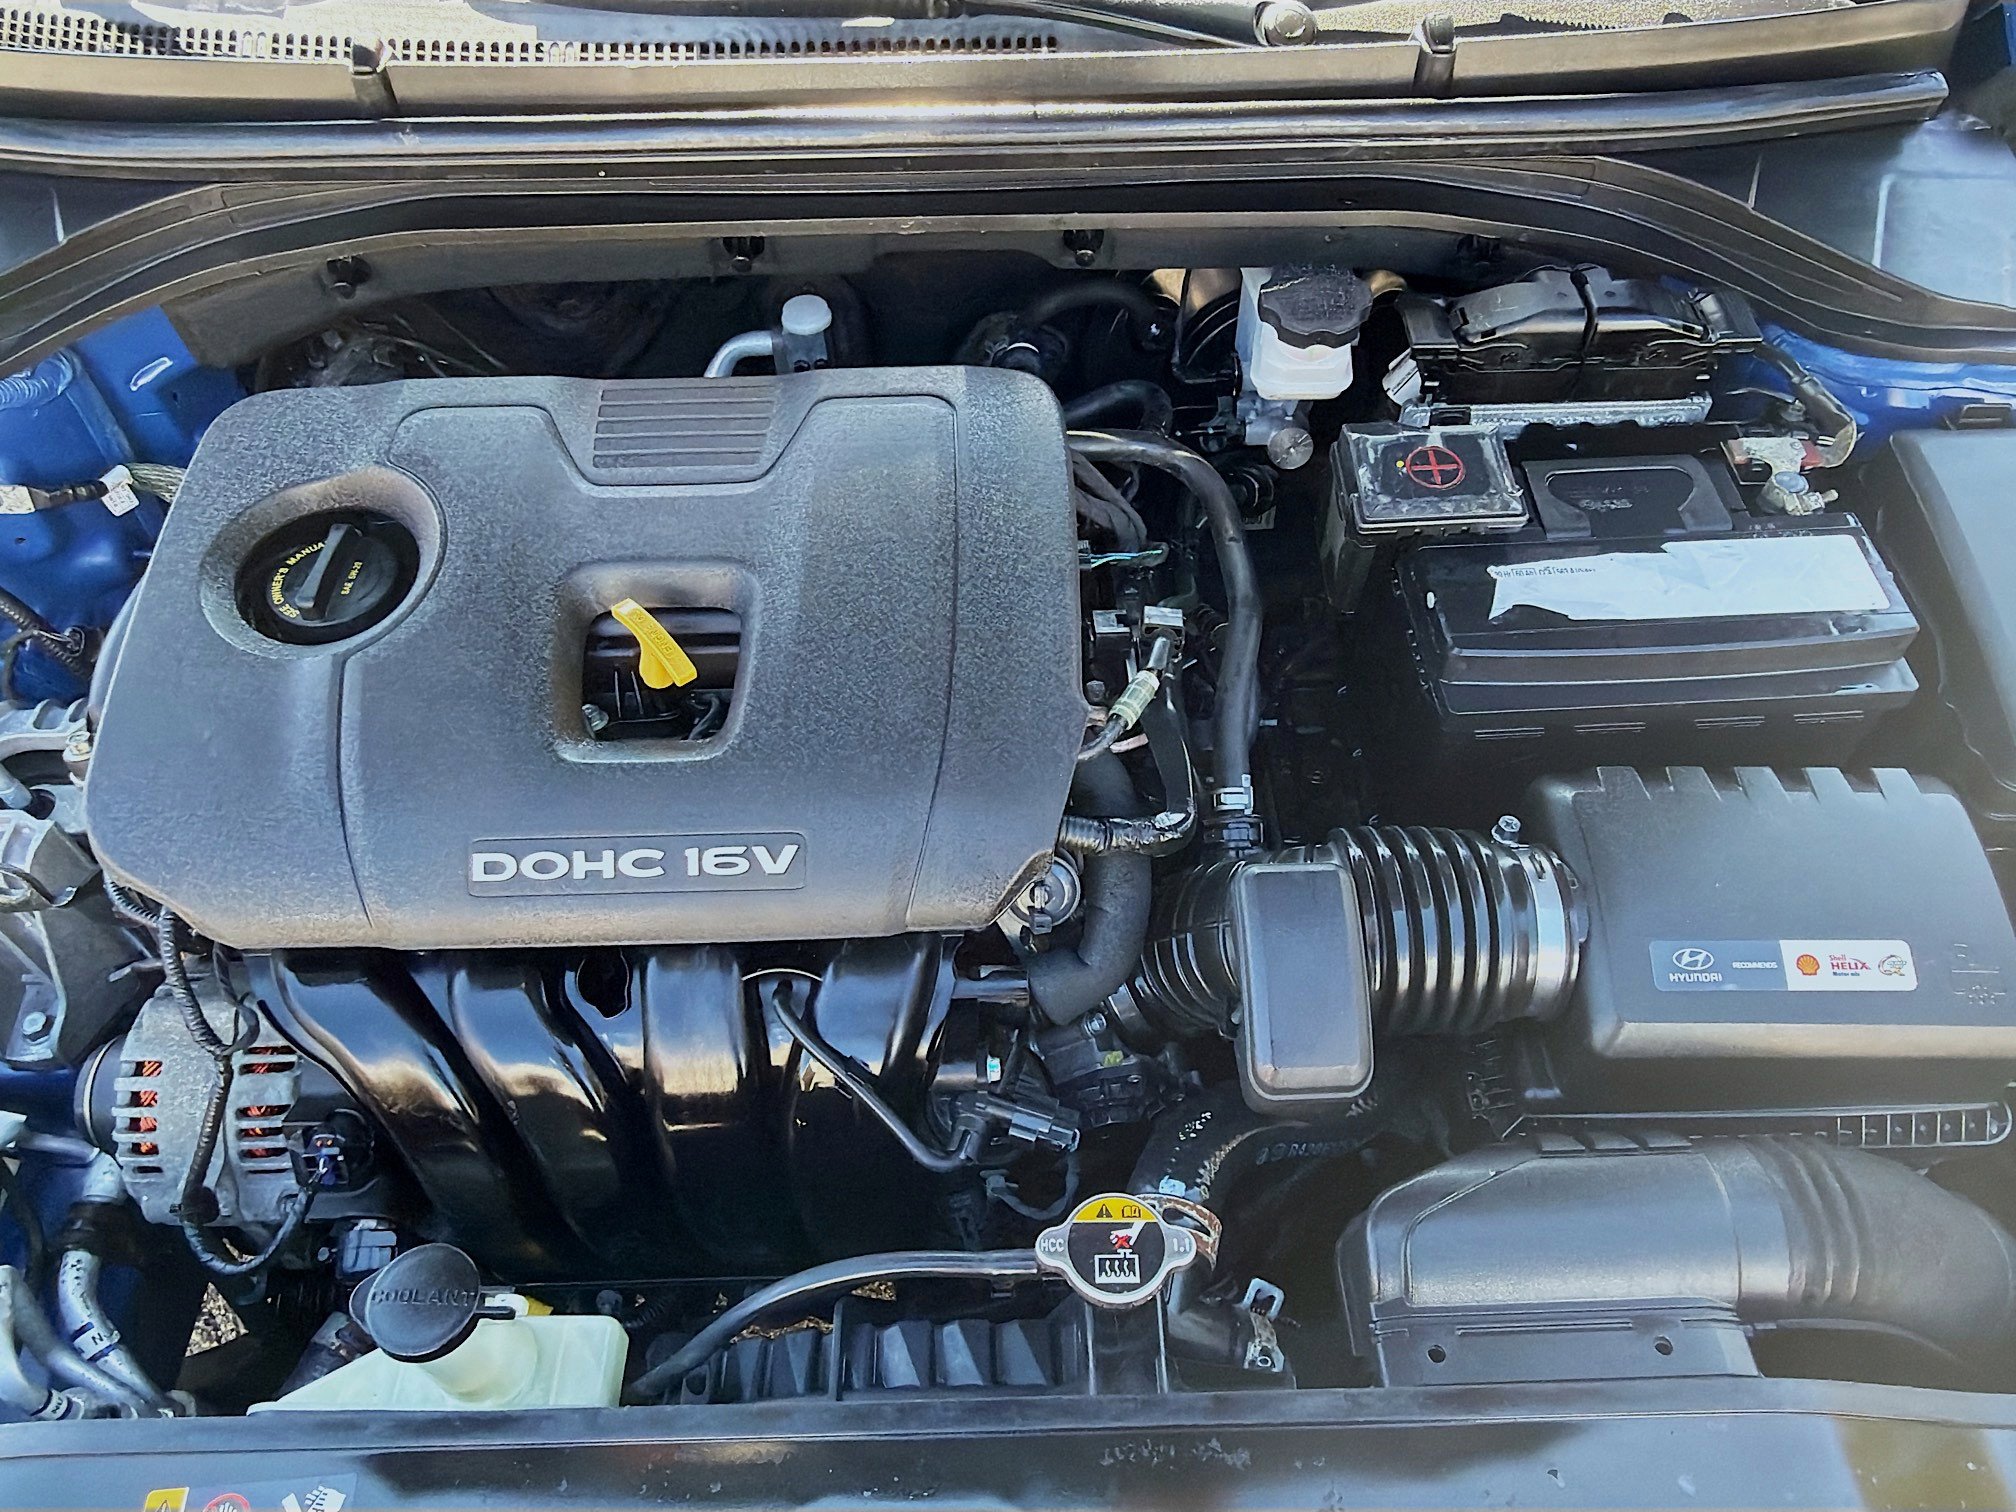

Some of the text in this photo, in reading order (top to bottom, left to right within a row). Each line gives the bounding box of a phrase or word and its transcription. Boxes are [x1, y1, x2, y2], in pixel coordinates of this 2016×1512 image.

[271, 541, 327, 618] SEE OWNER'S MANUA
[471, 844, 800, 882] DOHC 16V
[1732, 961, 1778, 969] RECOMMENDS
[1830, 962, 1871, 970] HELIX
[1668, 972, 1722, 982] HYUNDAI
[1040, 1238, 1065, 1252] HCC
[1172, 1238, 1190, 1252] 1.1
[371, 1288, 475, 1307] COOLANT
